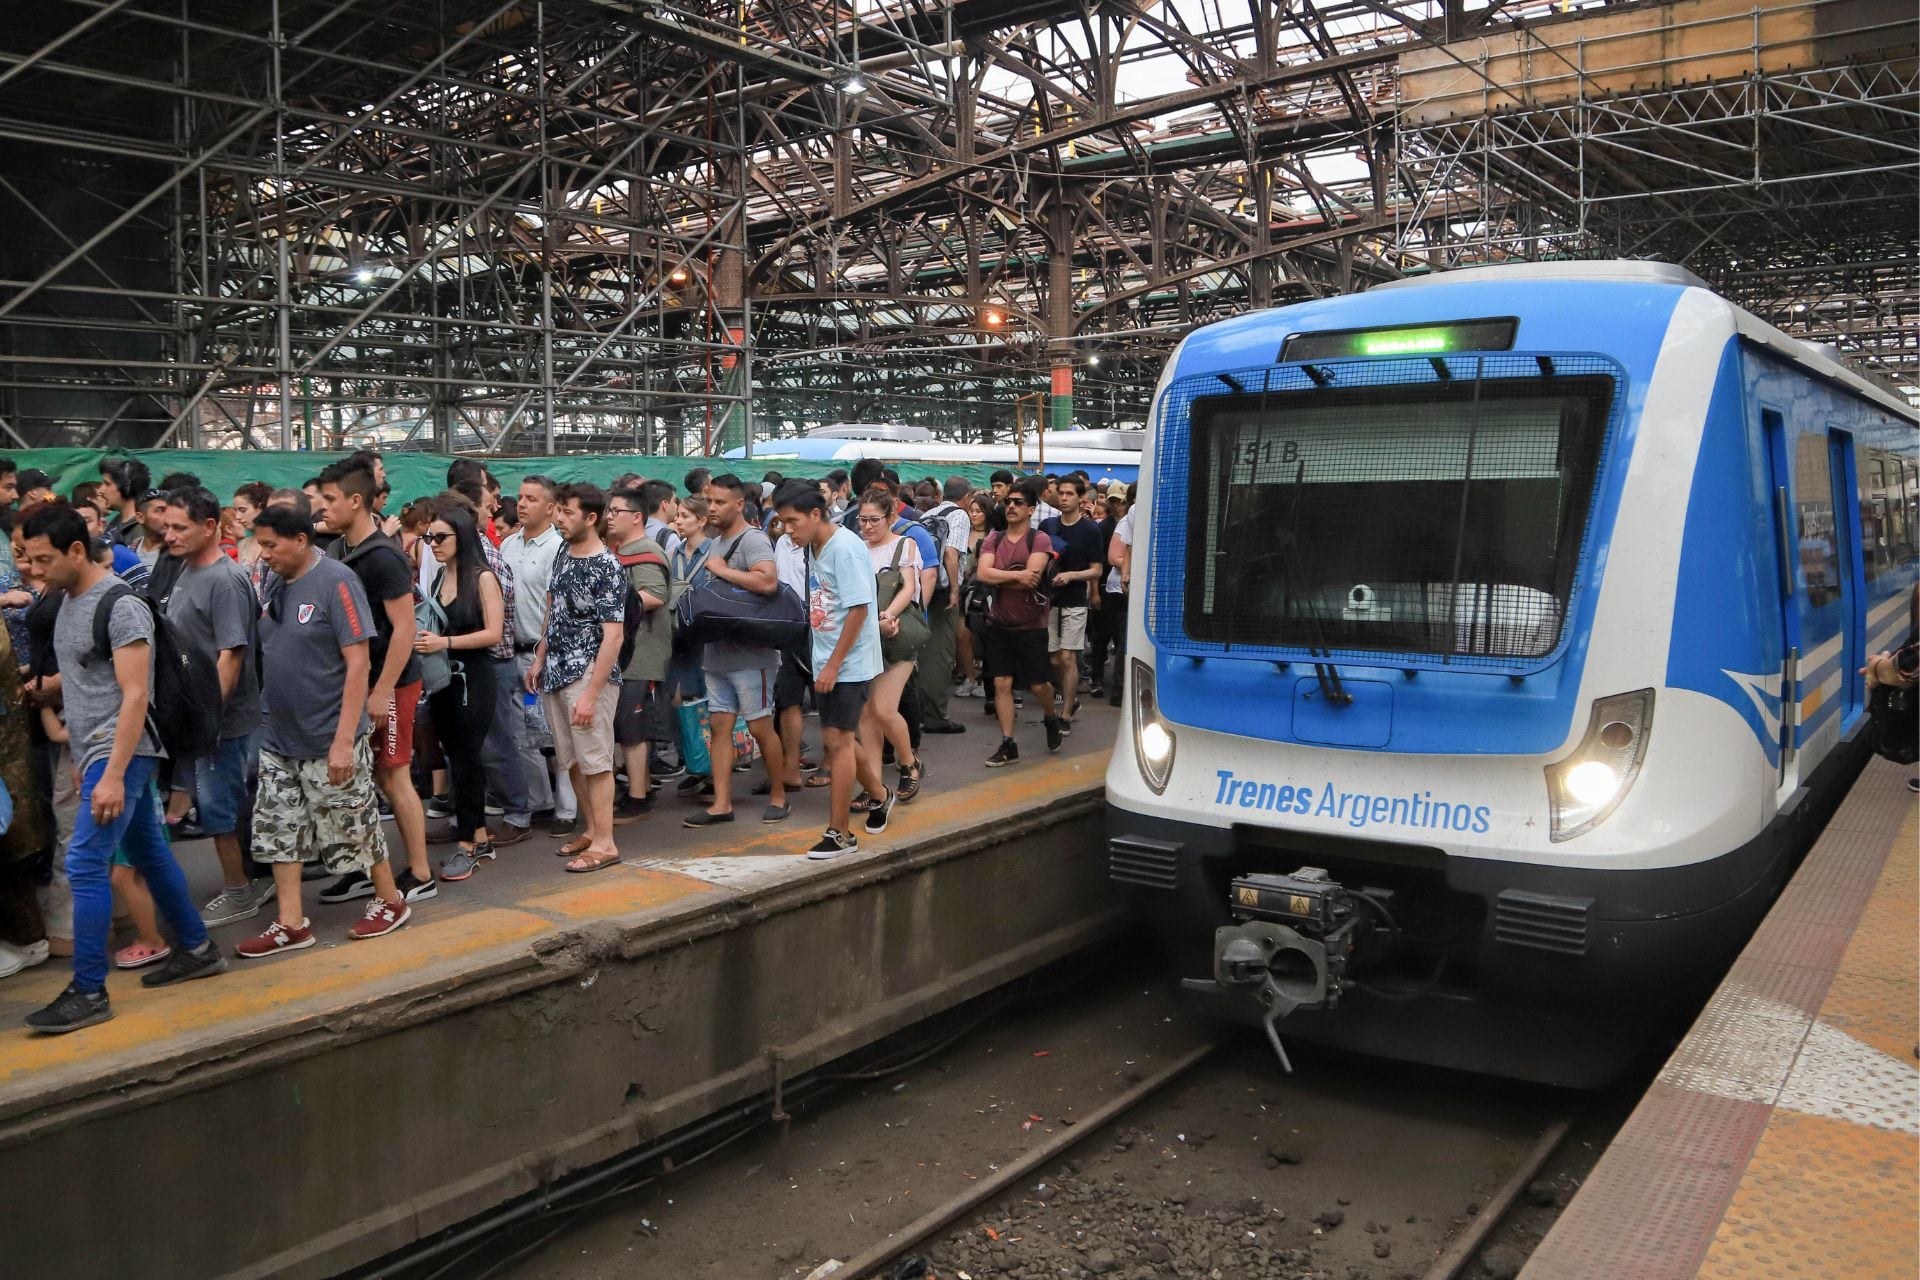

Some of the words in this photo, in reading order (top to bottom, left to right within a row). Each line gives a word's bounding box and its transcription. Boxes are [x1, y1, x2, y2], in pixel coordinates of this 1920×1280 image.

[1233, 439, 1272, 464] 151
[1282, 440, 1299, 463] B
[1215, 770, 1312, 815] Trenes
[1314, 782, 1491, 834] Argentinos
